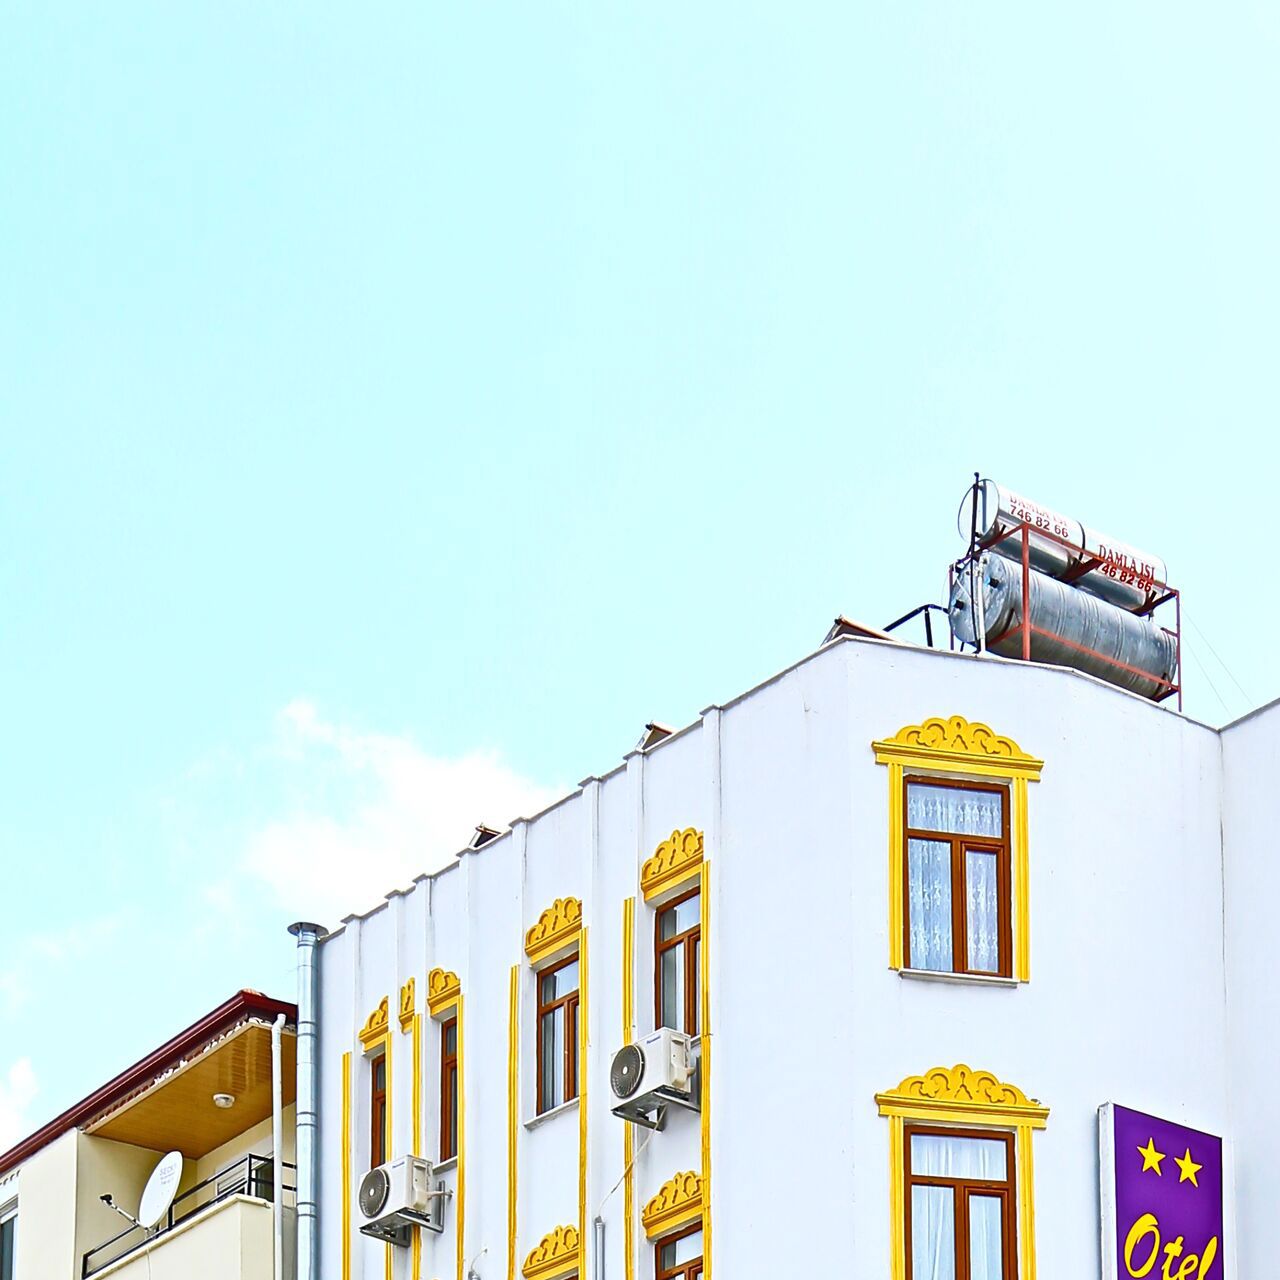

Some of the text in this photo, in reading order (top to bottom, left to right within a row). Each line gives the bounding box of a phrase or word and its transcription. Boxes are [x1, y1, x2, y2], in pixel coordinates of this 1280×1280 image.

[1010, 505, 1069, 538] 746 82 66
[1098, 544, 1138, 574] DAMLA
[1119, 571, 1135, 586] 82
[1137, 579, 1153, 593] 66
